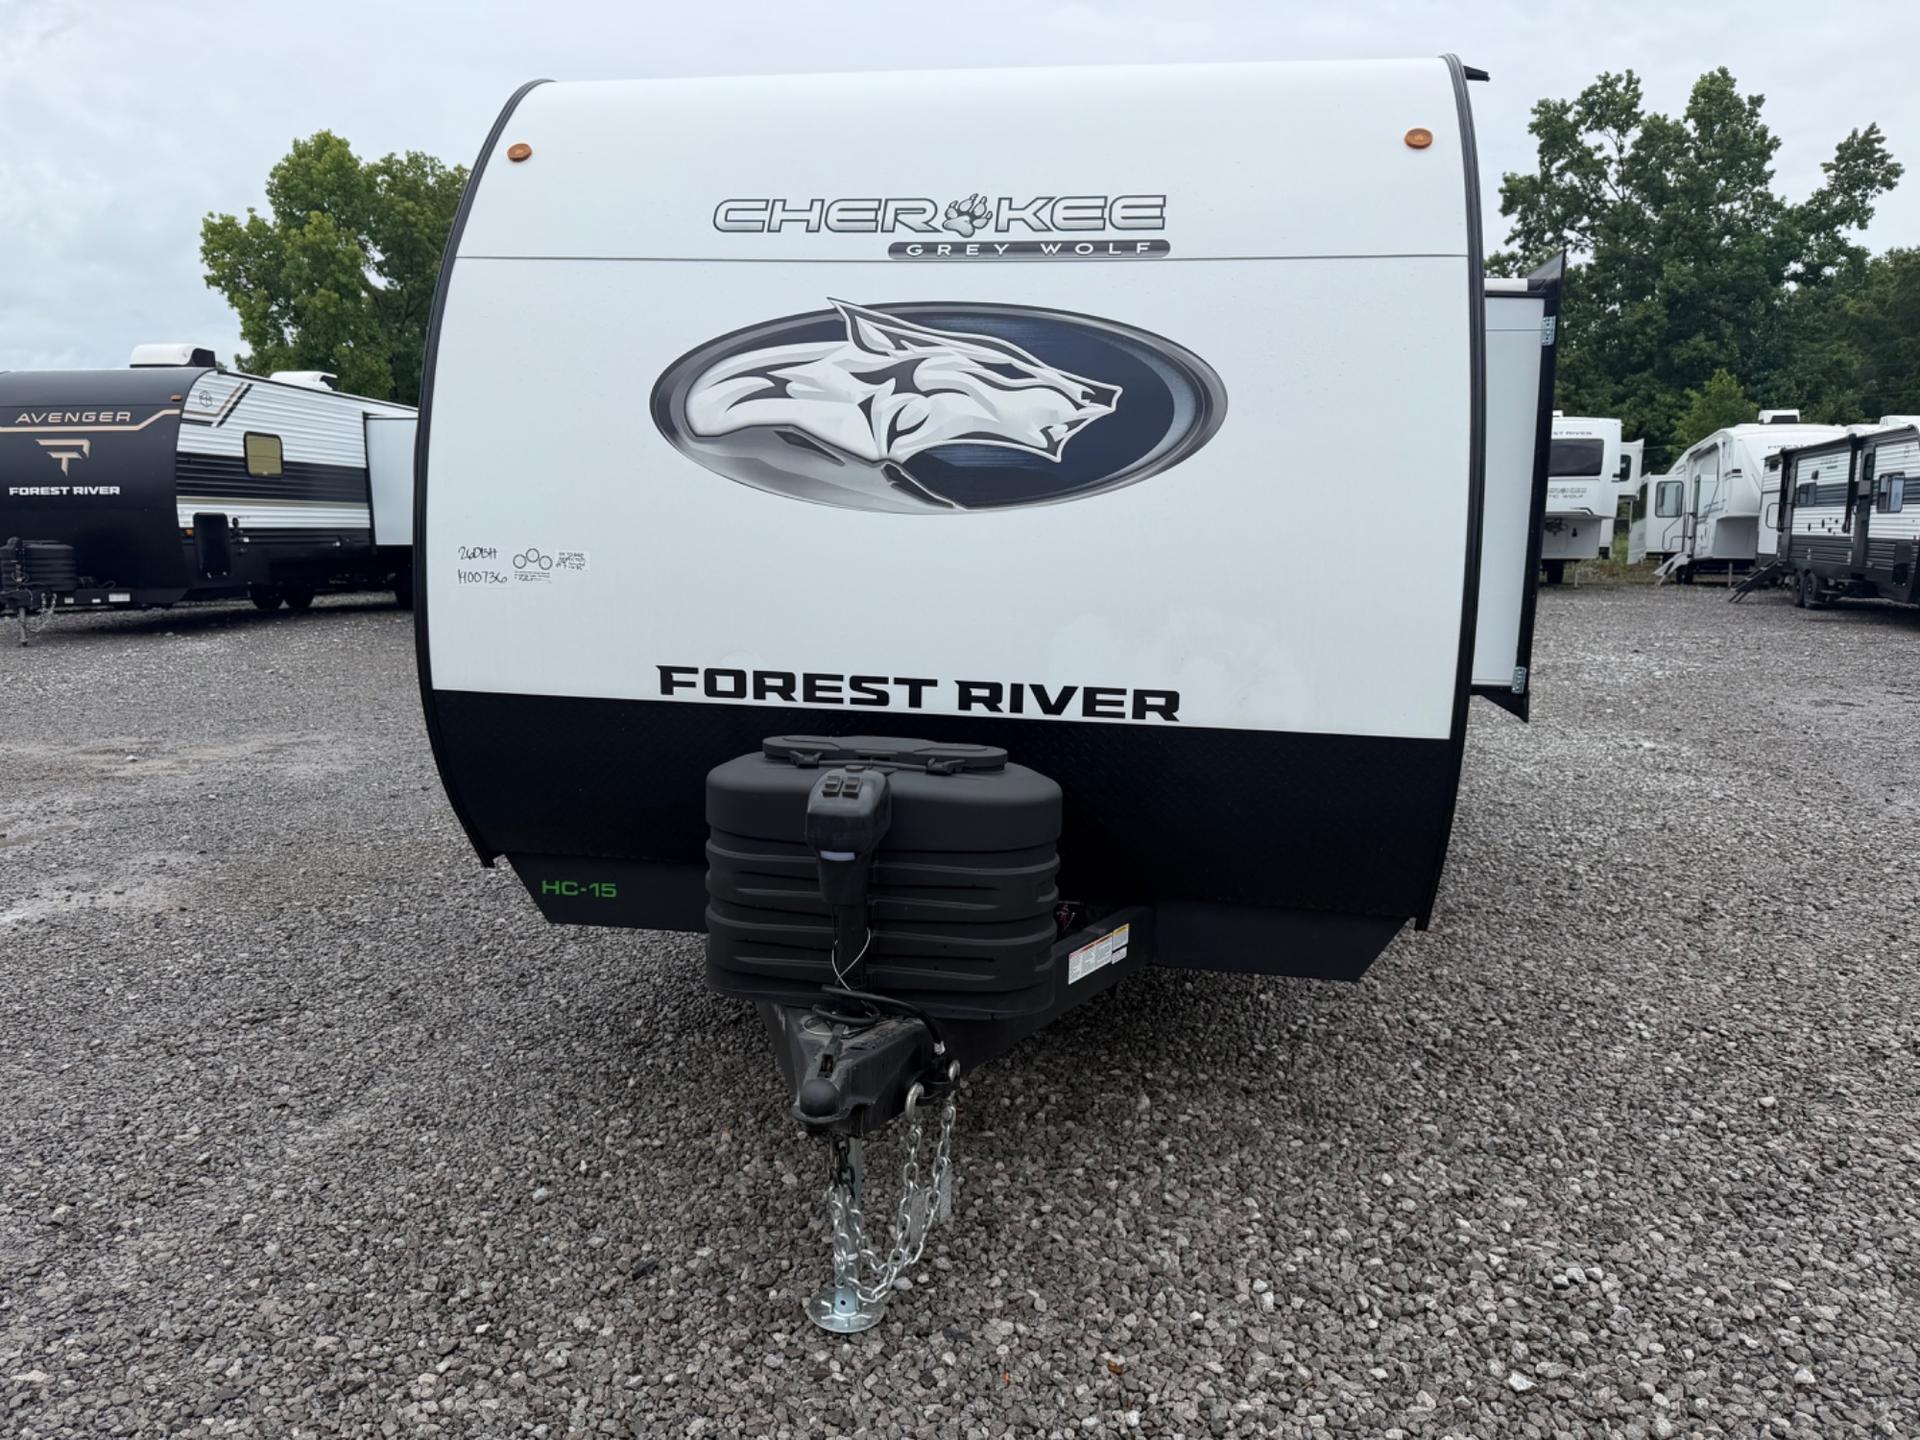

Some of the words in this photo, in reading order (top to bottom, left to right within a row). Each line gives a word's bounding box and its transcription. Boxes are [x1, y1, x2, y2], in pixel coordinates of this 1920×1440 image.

[905, 243, 1010, 257] GREY
[1040, 242, 1152, 257] WOLF
[15, 411, 131, 424] AVENGER
[8, 486, 70, 496] FOREST
[72, 485, 121, 495] RIVER
[655, 664, 939, 709] FOREST
[953, 679, 1181, 722] RIVER
[541, 879, 618, 898] HC-15
